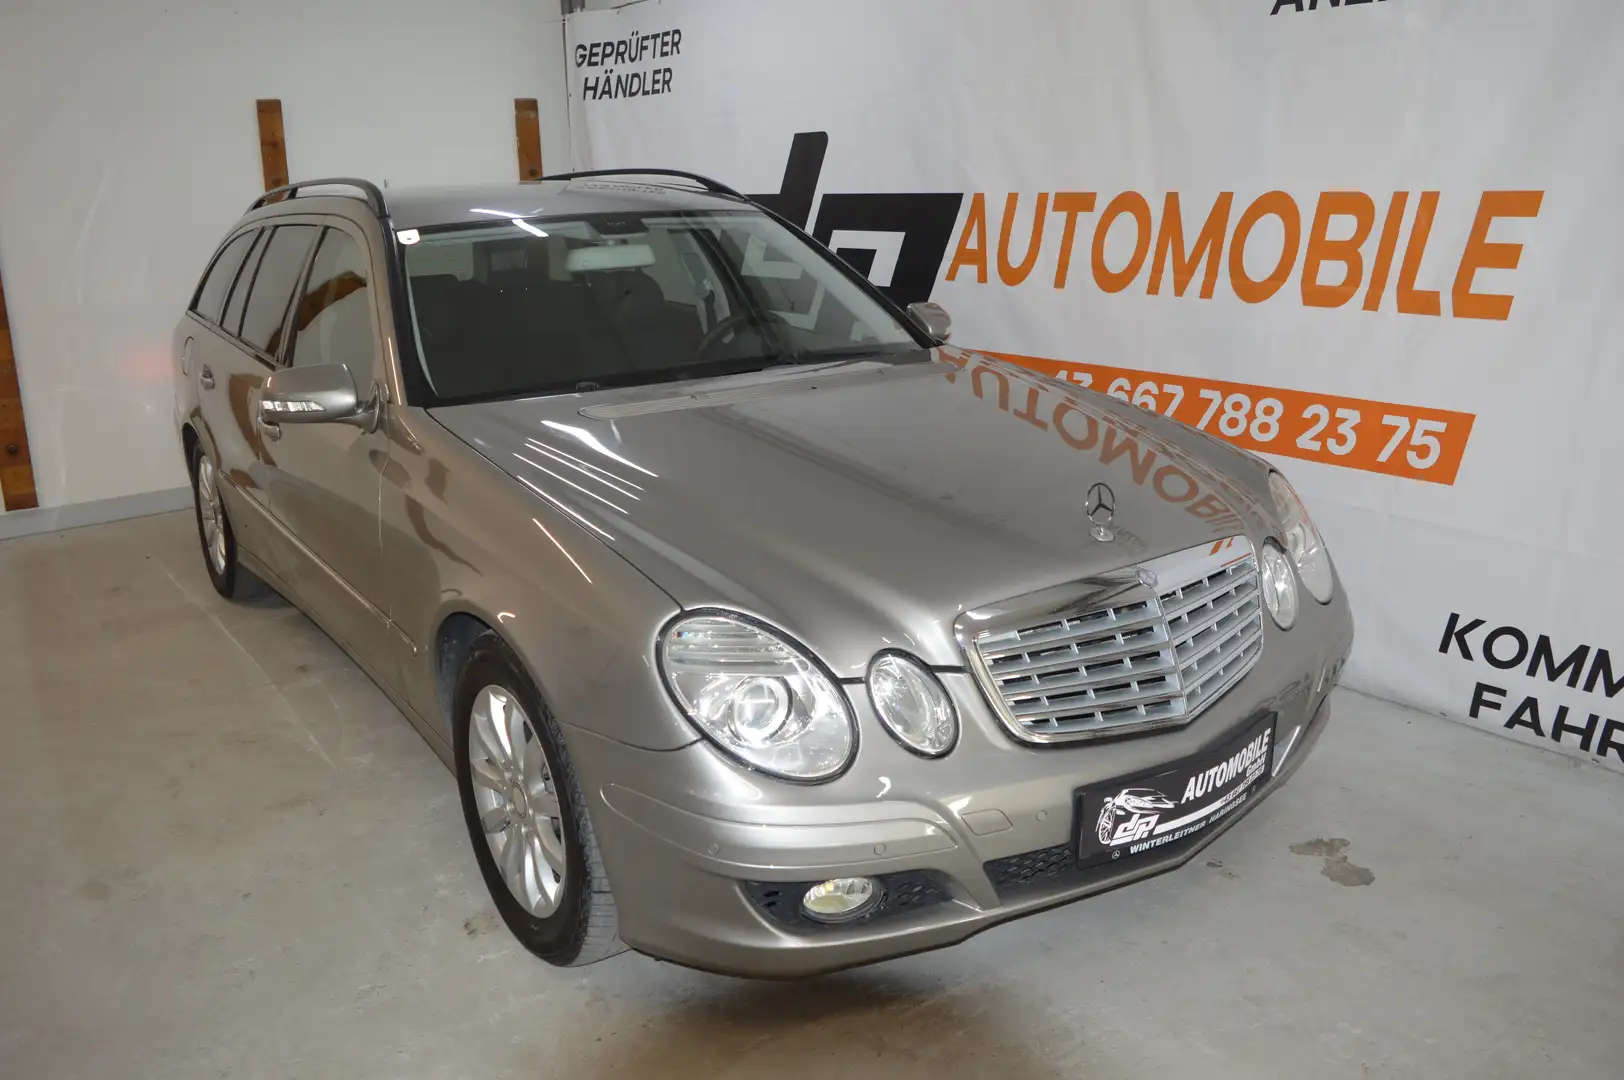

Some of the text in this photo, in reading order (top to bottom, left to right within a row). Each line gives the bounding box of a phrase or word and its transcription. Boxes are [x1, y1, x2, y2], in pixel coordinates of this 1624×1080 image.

[575, 29, 682, 68] GEPRÜFTER
[583, 67, 673, 101] HÄNDLER
[945, 190, 1545, 321] AUTOMOBILE
[1196, 388, 1284, 443] 788
[1295, 403, 1362, 456] 23
[1375, 414, 1448, 470] 75
[1181, 728, 1272, 804] AUTOMOBILE
[1129, 821, 1207, 854] WINTERLEITNER
